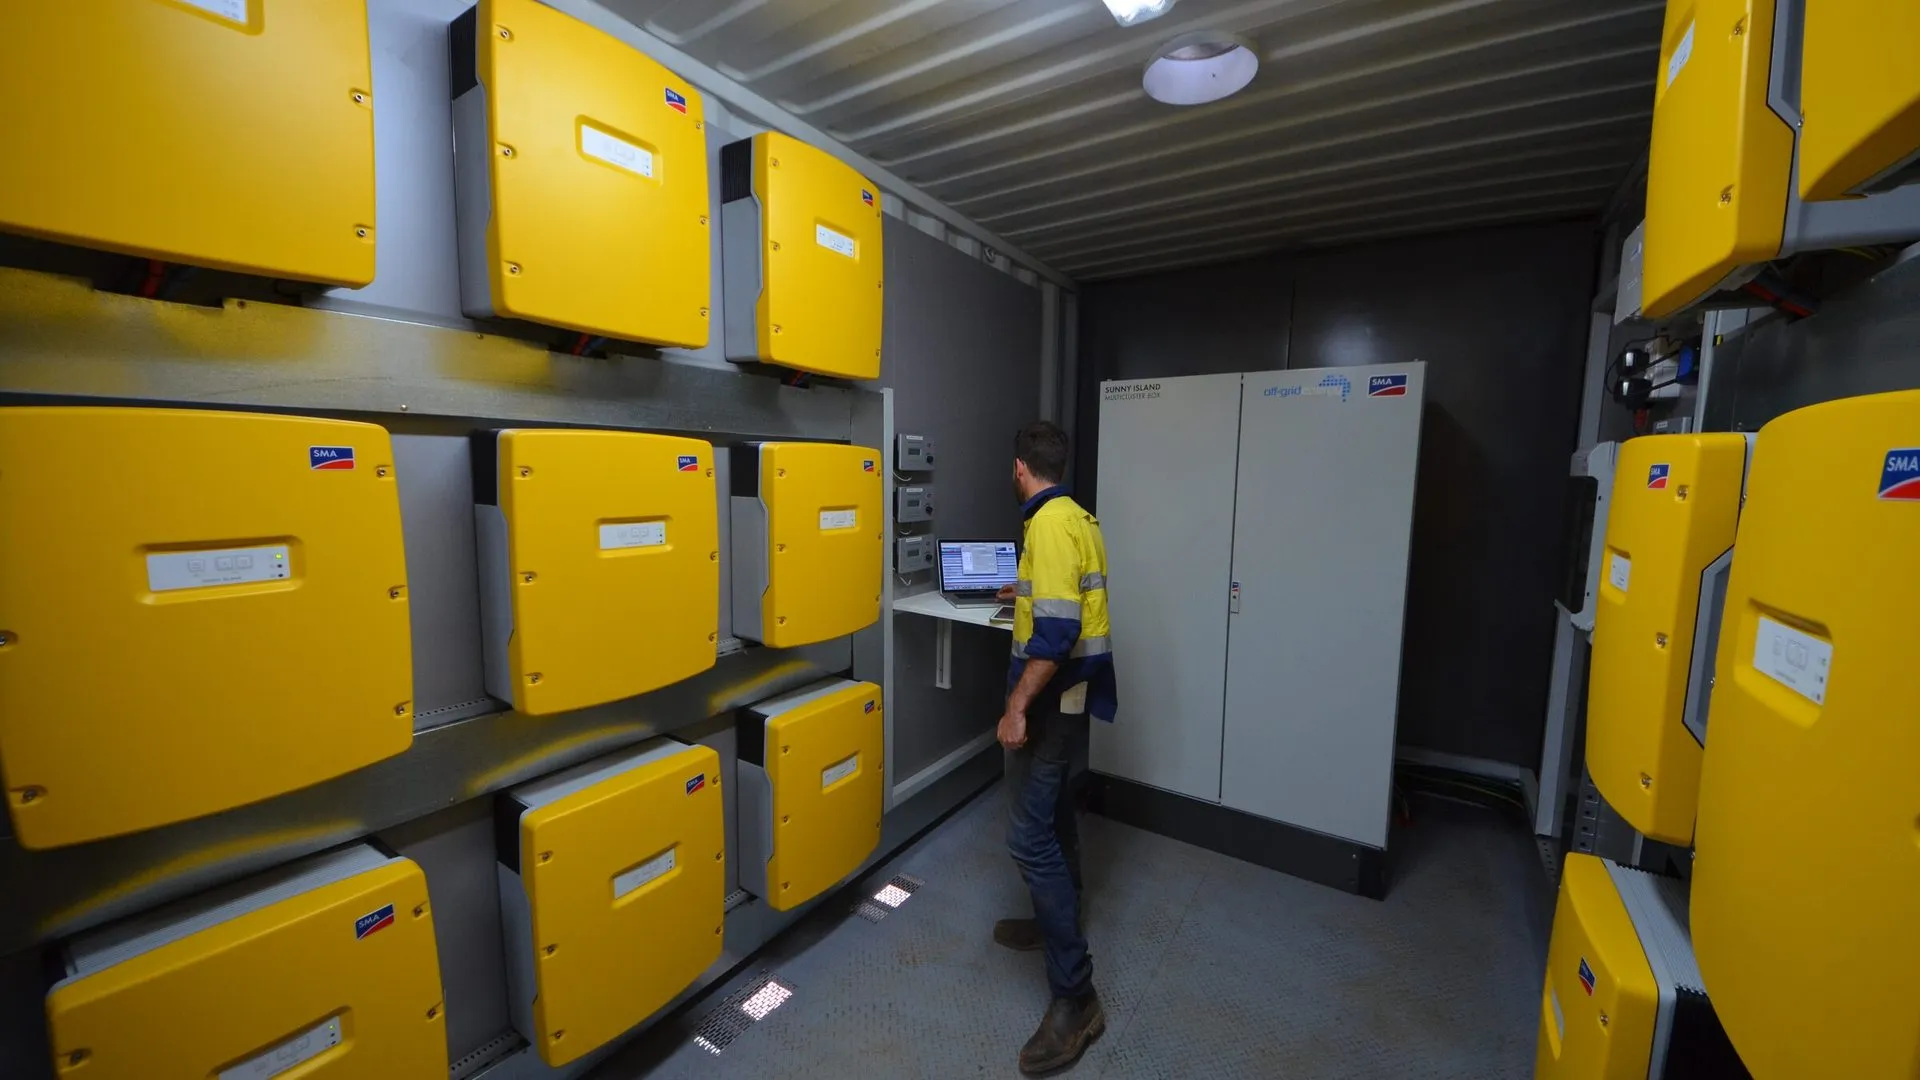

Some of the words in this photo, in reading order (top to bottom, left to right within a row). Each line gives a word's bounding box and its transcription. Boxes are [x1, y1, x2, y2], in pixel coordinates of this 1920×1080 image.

[1105, 385, 1131, 393] SUNNY
[1133, 383, 1160, 392] ISLAND
[313, 449, 337, 457] SMA
[1887, 456, 1918, 471] SMA
[359, 914, 380, 925] SMA
